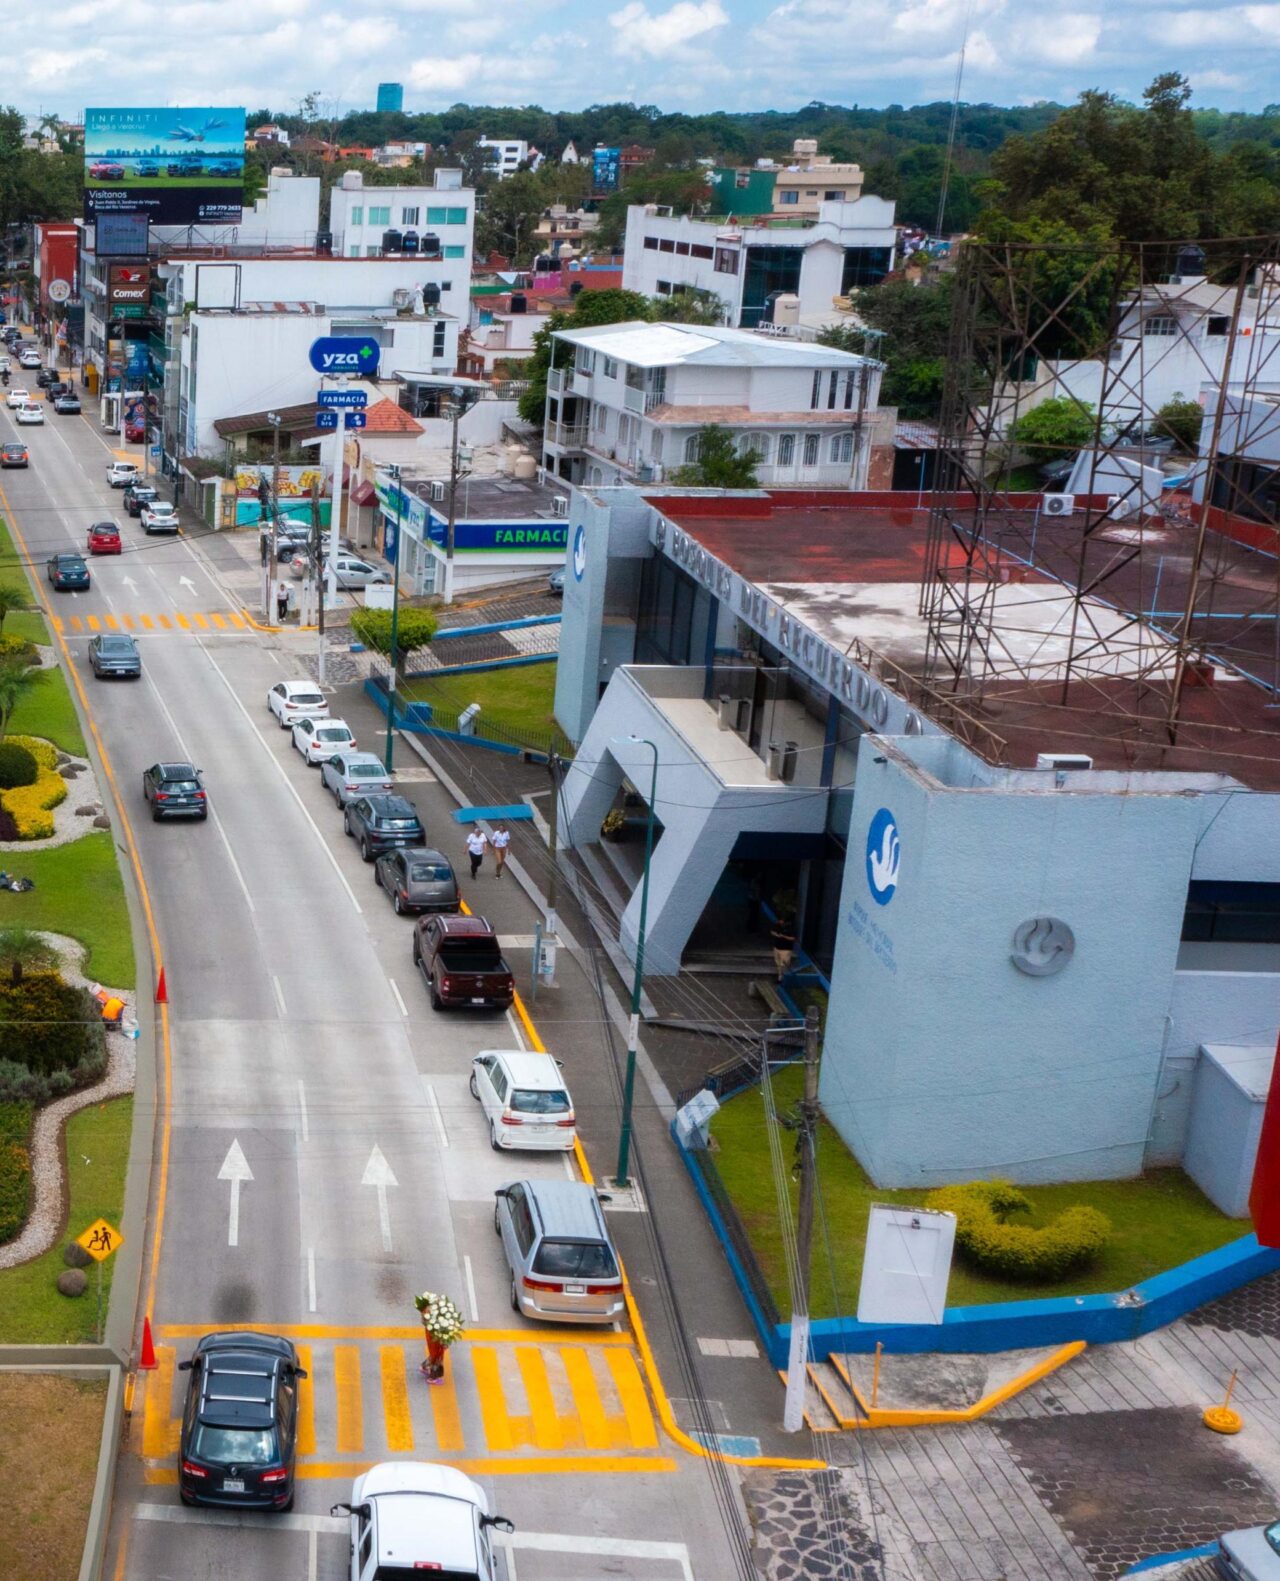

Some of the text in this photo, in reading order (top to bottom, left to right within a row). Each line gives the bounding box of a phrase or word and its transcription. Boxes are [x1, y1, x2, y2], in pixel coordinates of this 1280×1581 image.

[91, 114, 158, 122] INFINITI
[113, 289, 146, 298] Comex
[322, 353, 360, 367] yza
[672, 530, 889, 726] BOSQUES DEL RECUERDO
